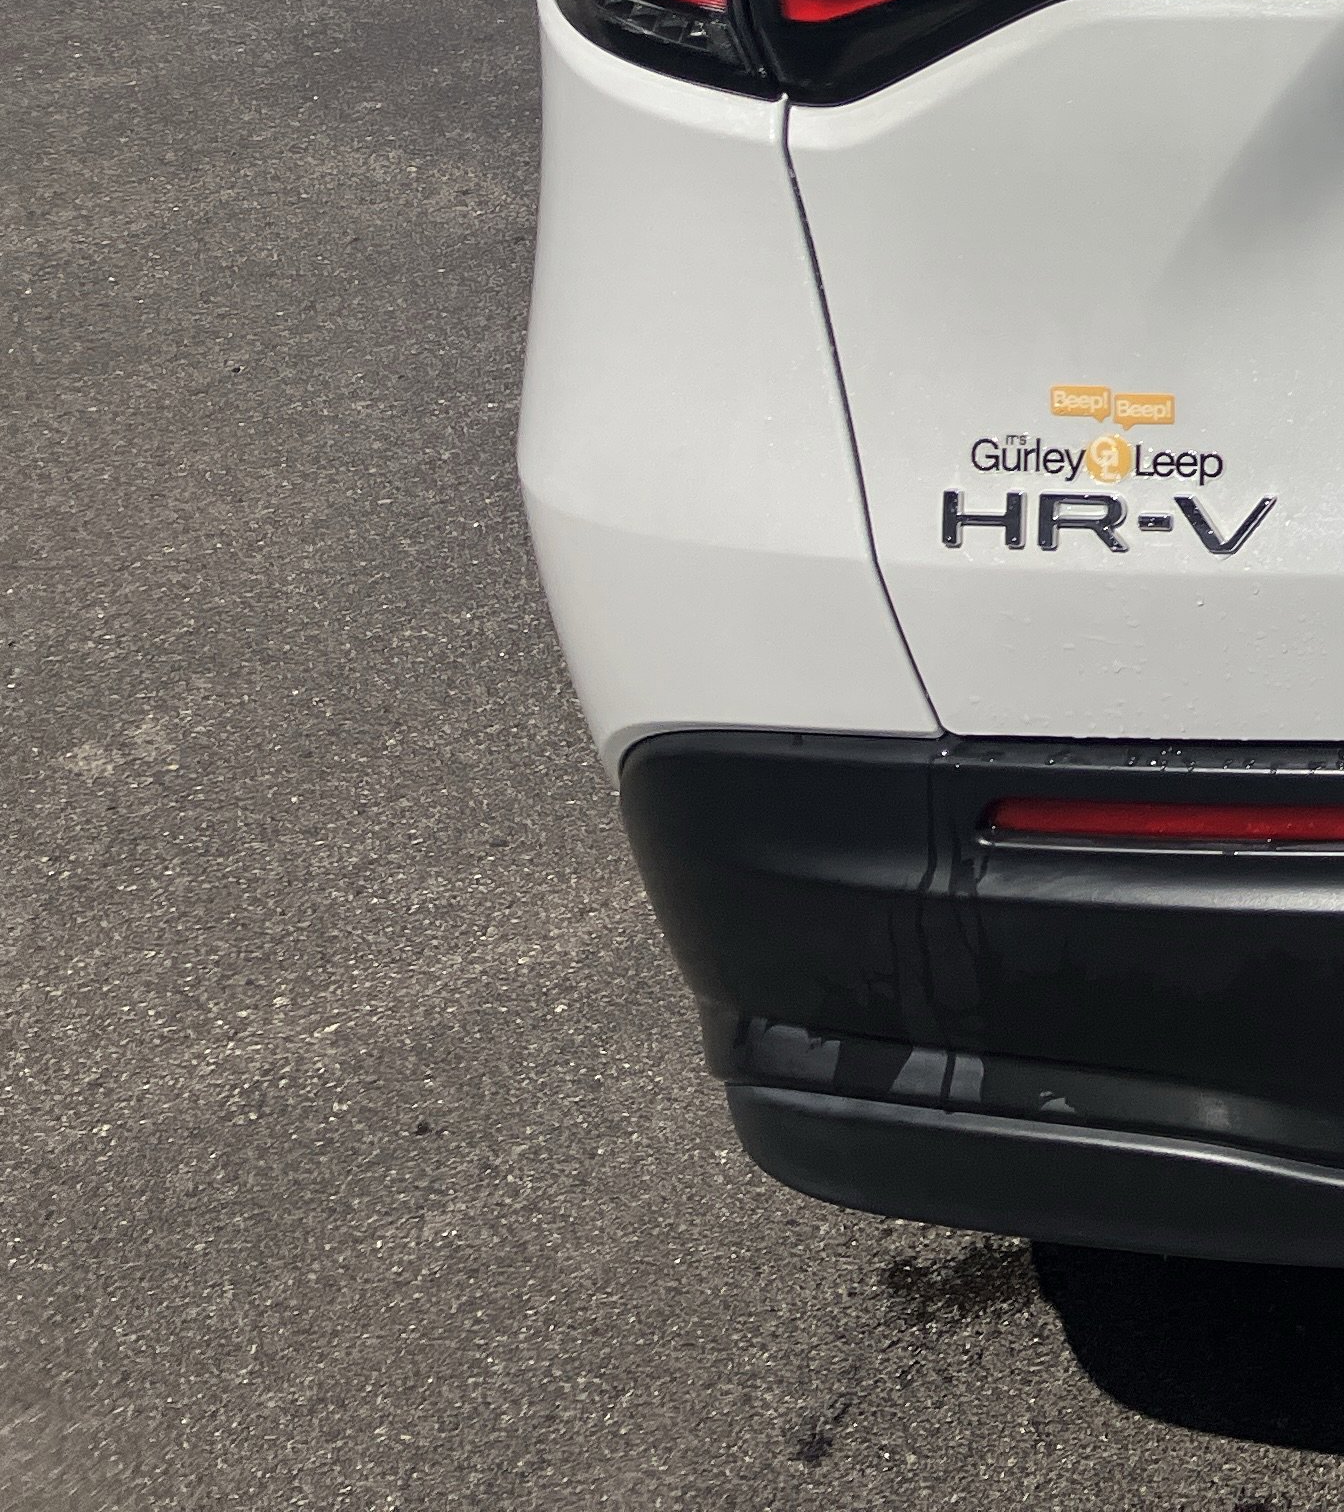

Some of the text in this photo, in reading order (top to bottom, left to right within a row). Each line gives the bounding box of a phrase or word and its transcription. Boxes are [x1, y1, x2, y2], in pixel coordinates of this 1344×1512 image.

[1054, 391, 1172, 419] Beep! Beep!
[971, 437, 1086, 481] Gurley
[1135, 444, 1224, 486] Leep
[942, 489, 1278, 556] HR-V
